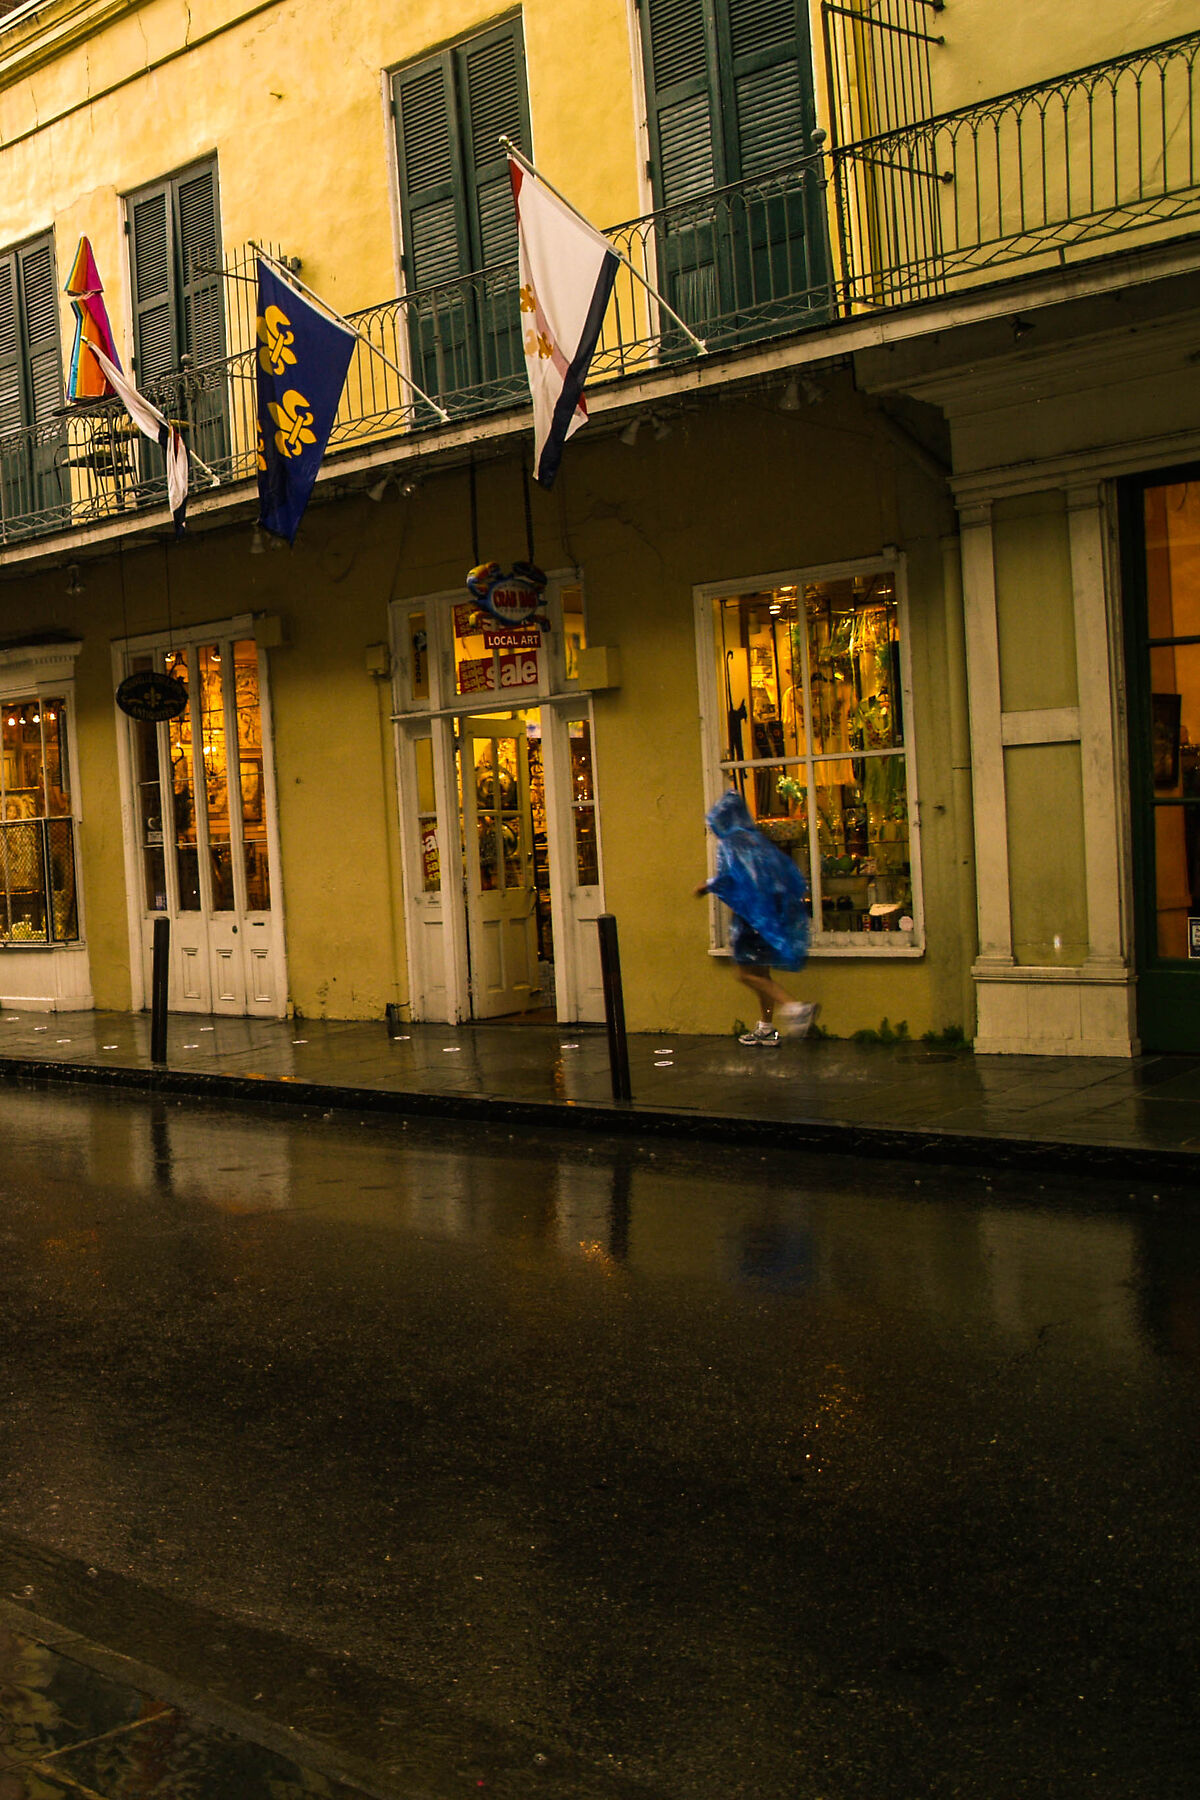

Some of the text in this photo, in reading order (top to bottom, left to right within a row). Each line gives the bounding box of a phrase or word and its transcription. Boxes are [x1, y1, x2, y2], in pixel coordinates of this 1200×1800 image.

[488, 635, 539, 646] LOCAL ART
[486, 655, 537, 688] sale
